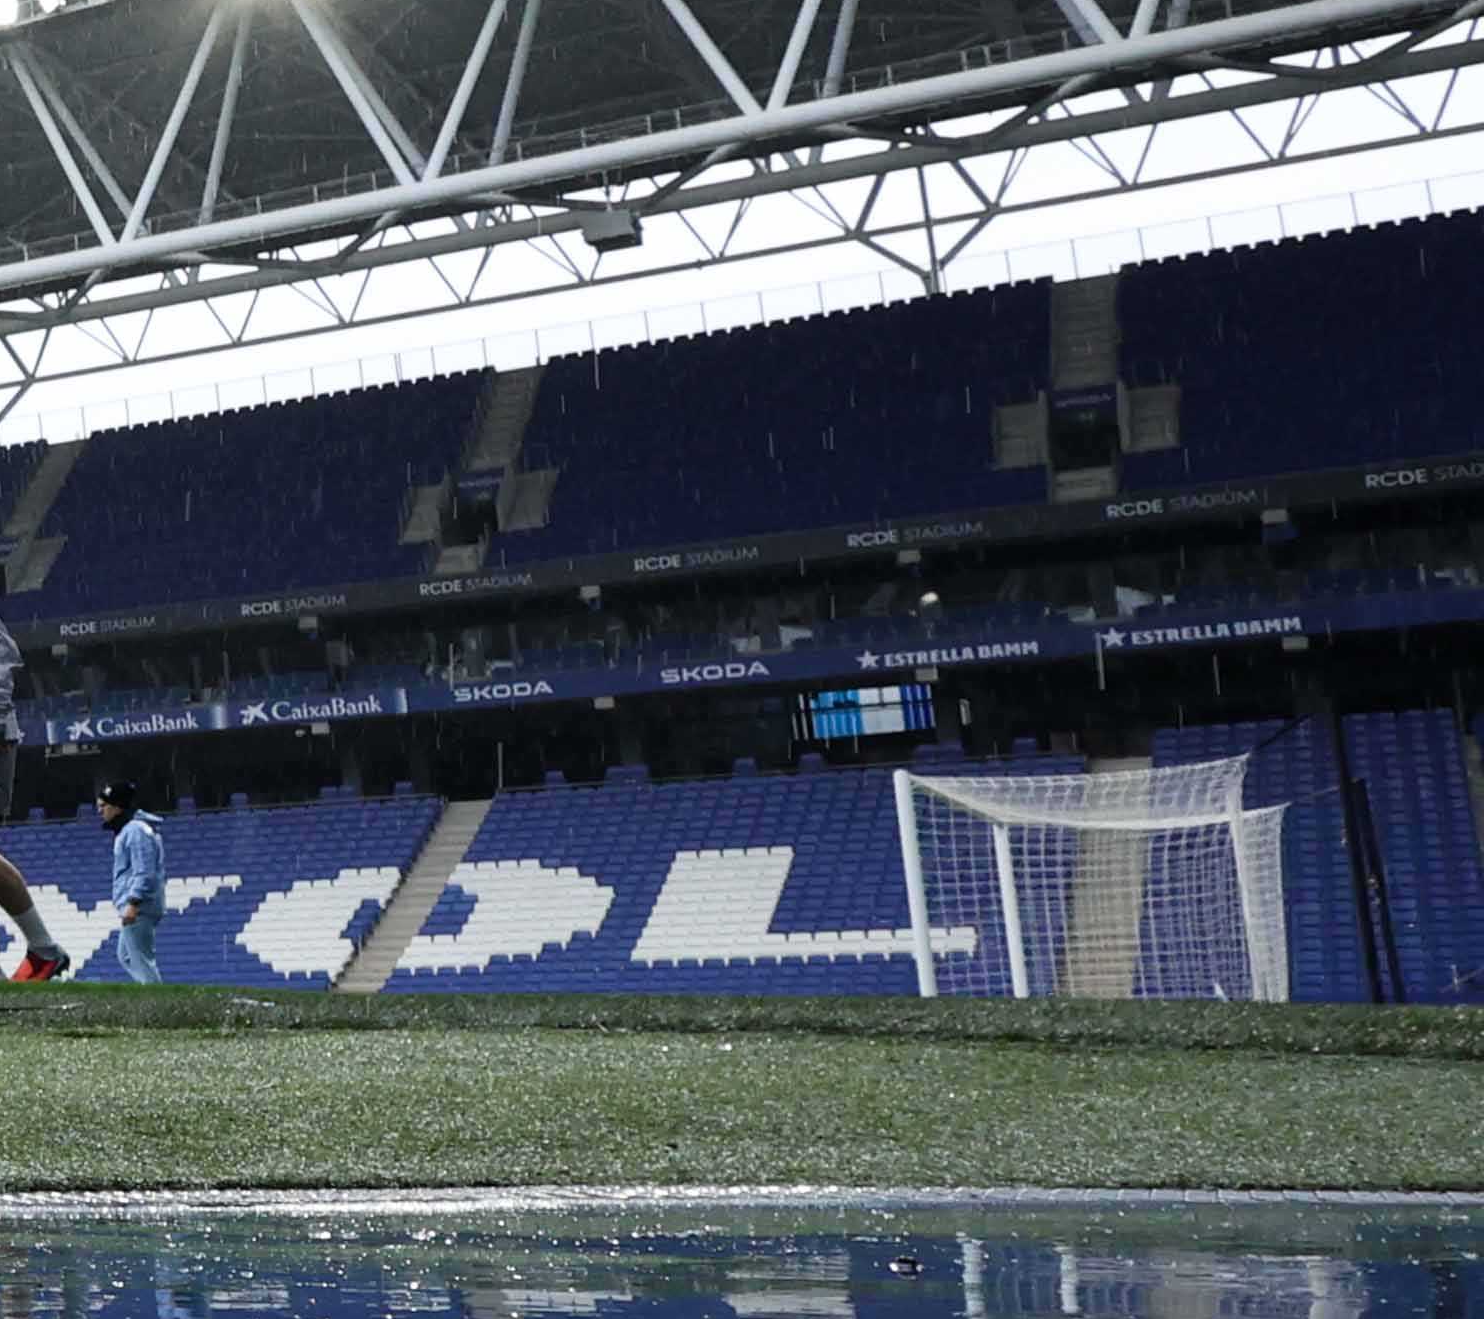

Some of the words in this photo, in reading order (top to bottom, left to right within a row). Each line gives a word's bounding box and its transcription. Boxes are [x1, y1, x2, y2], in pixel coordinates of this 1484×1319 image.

[1365, 468, 1428, 489] RCDE
[1106, 499, 1164, 519] RCDE
[1170, 489, 1259, 510] STADIUM
[846, 529, 898, 548] RCDE
[904, 522, 983, 540] STADIUM
[634, 554, 681, 572] RCDE
[684, 547, 759, 565] STADIUM
[419, 580, 463, 596] RCDE
[465, 574, 533, 591] STADIUM
[241, 600, 281, 617] RCDE
[284, 595, 346, 612] STADIUM
[59, 621, 96, 636] RCDE
[99, 616, 156, 632] STADIUM
[1131, 622, 1230, 646] ESTRELLA
[1234, 616, 1302, 637] DAMM
[884, 647, 975, 669] ESTRELLA
[979, 641, 1039, 661] DAMM
[661, 661, 770, 684] SKODA
[454, 681, 553, 703] SKODA
[271, 694, 382, 721] CaixaBank
[97, 711, 199, 737] CaixaBank
